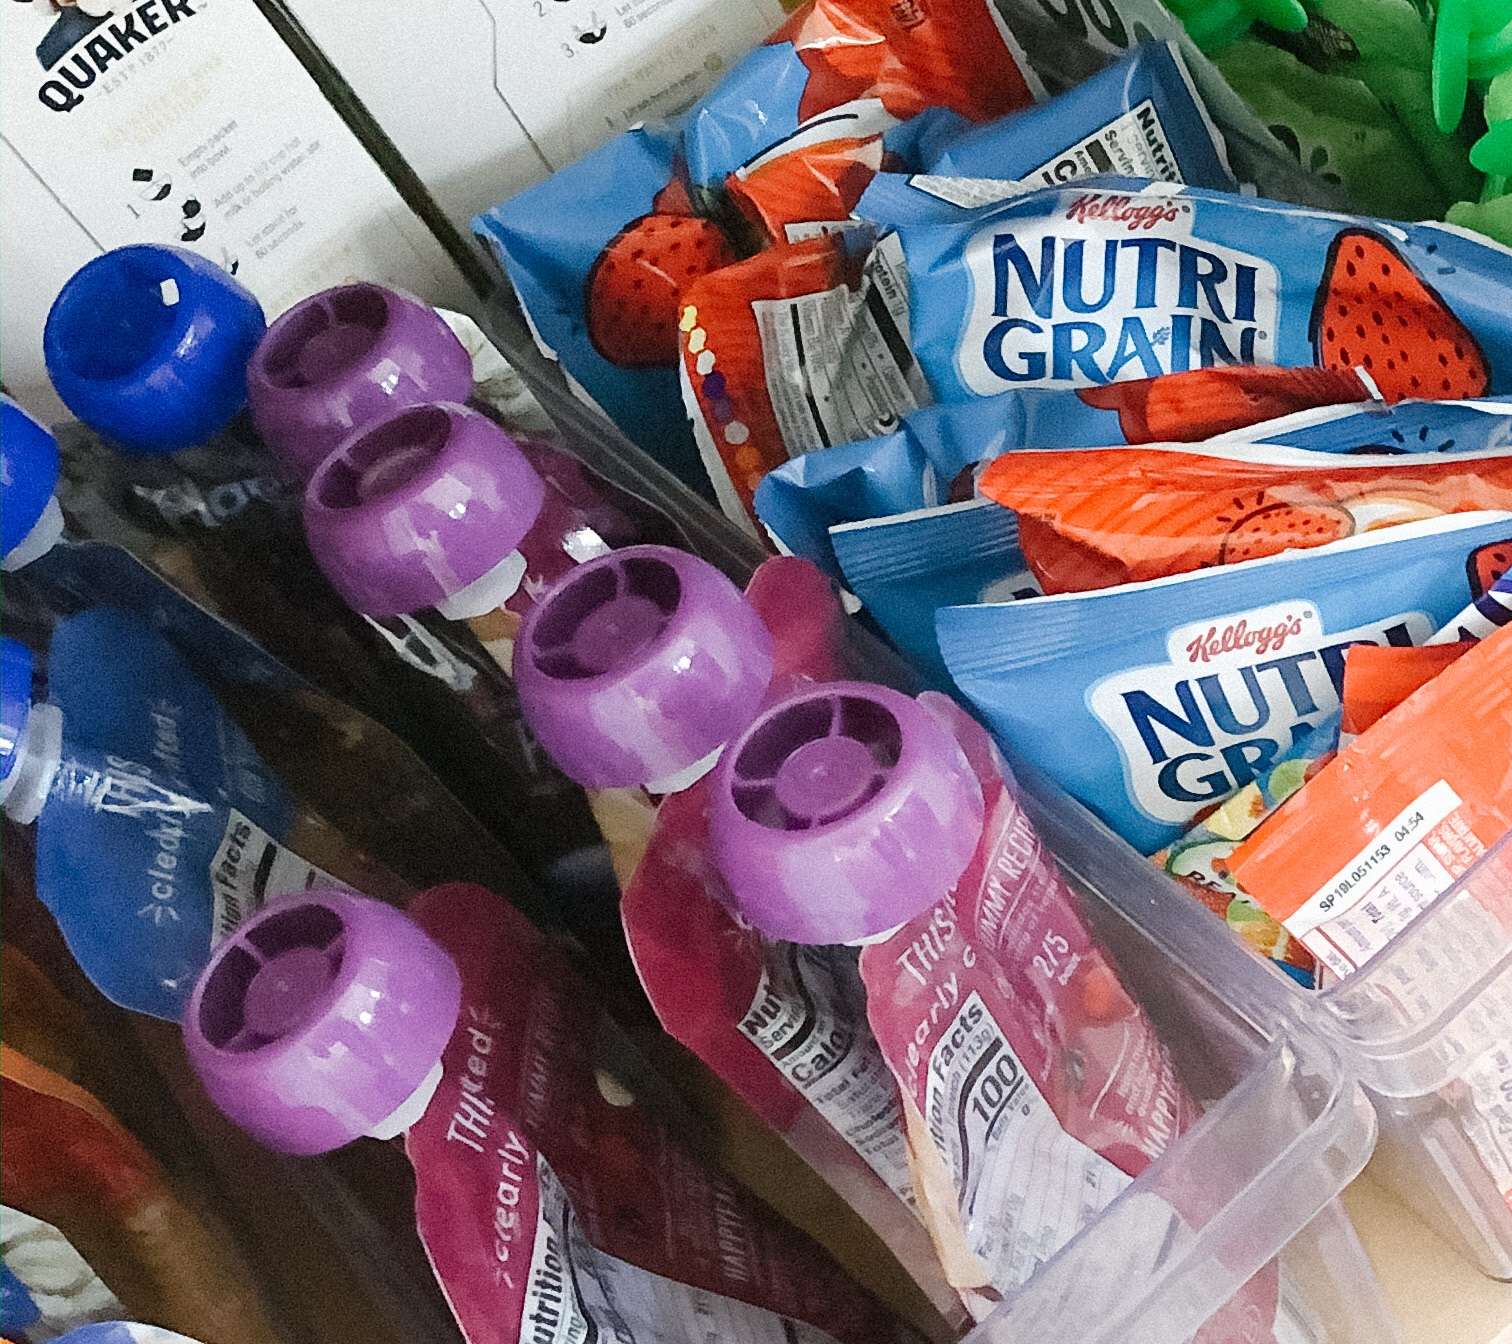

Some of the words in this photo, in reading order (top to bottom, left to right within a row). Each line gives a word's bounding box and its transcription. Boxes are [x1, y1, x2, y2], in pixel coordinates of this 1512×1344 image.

[533, 0, 547, 18] 2
[561, 43, 575, 58] 3
[1066, 193, 1183, 228] Kellogg's
[991, 230, 1260, 327] NUTRI
[981, 314, 1258, 384] GRAIN
[1186, 611, 1305, 664] Kellogg's
[939, 1000, 985, 1059] Facts
[969, 1052, 1020, 1124] 100
